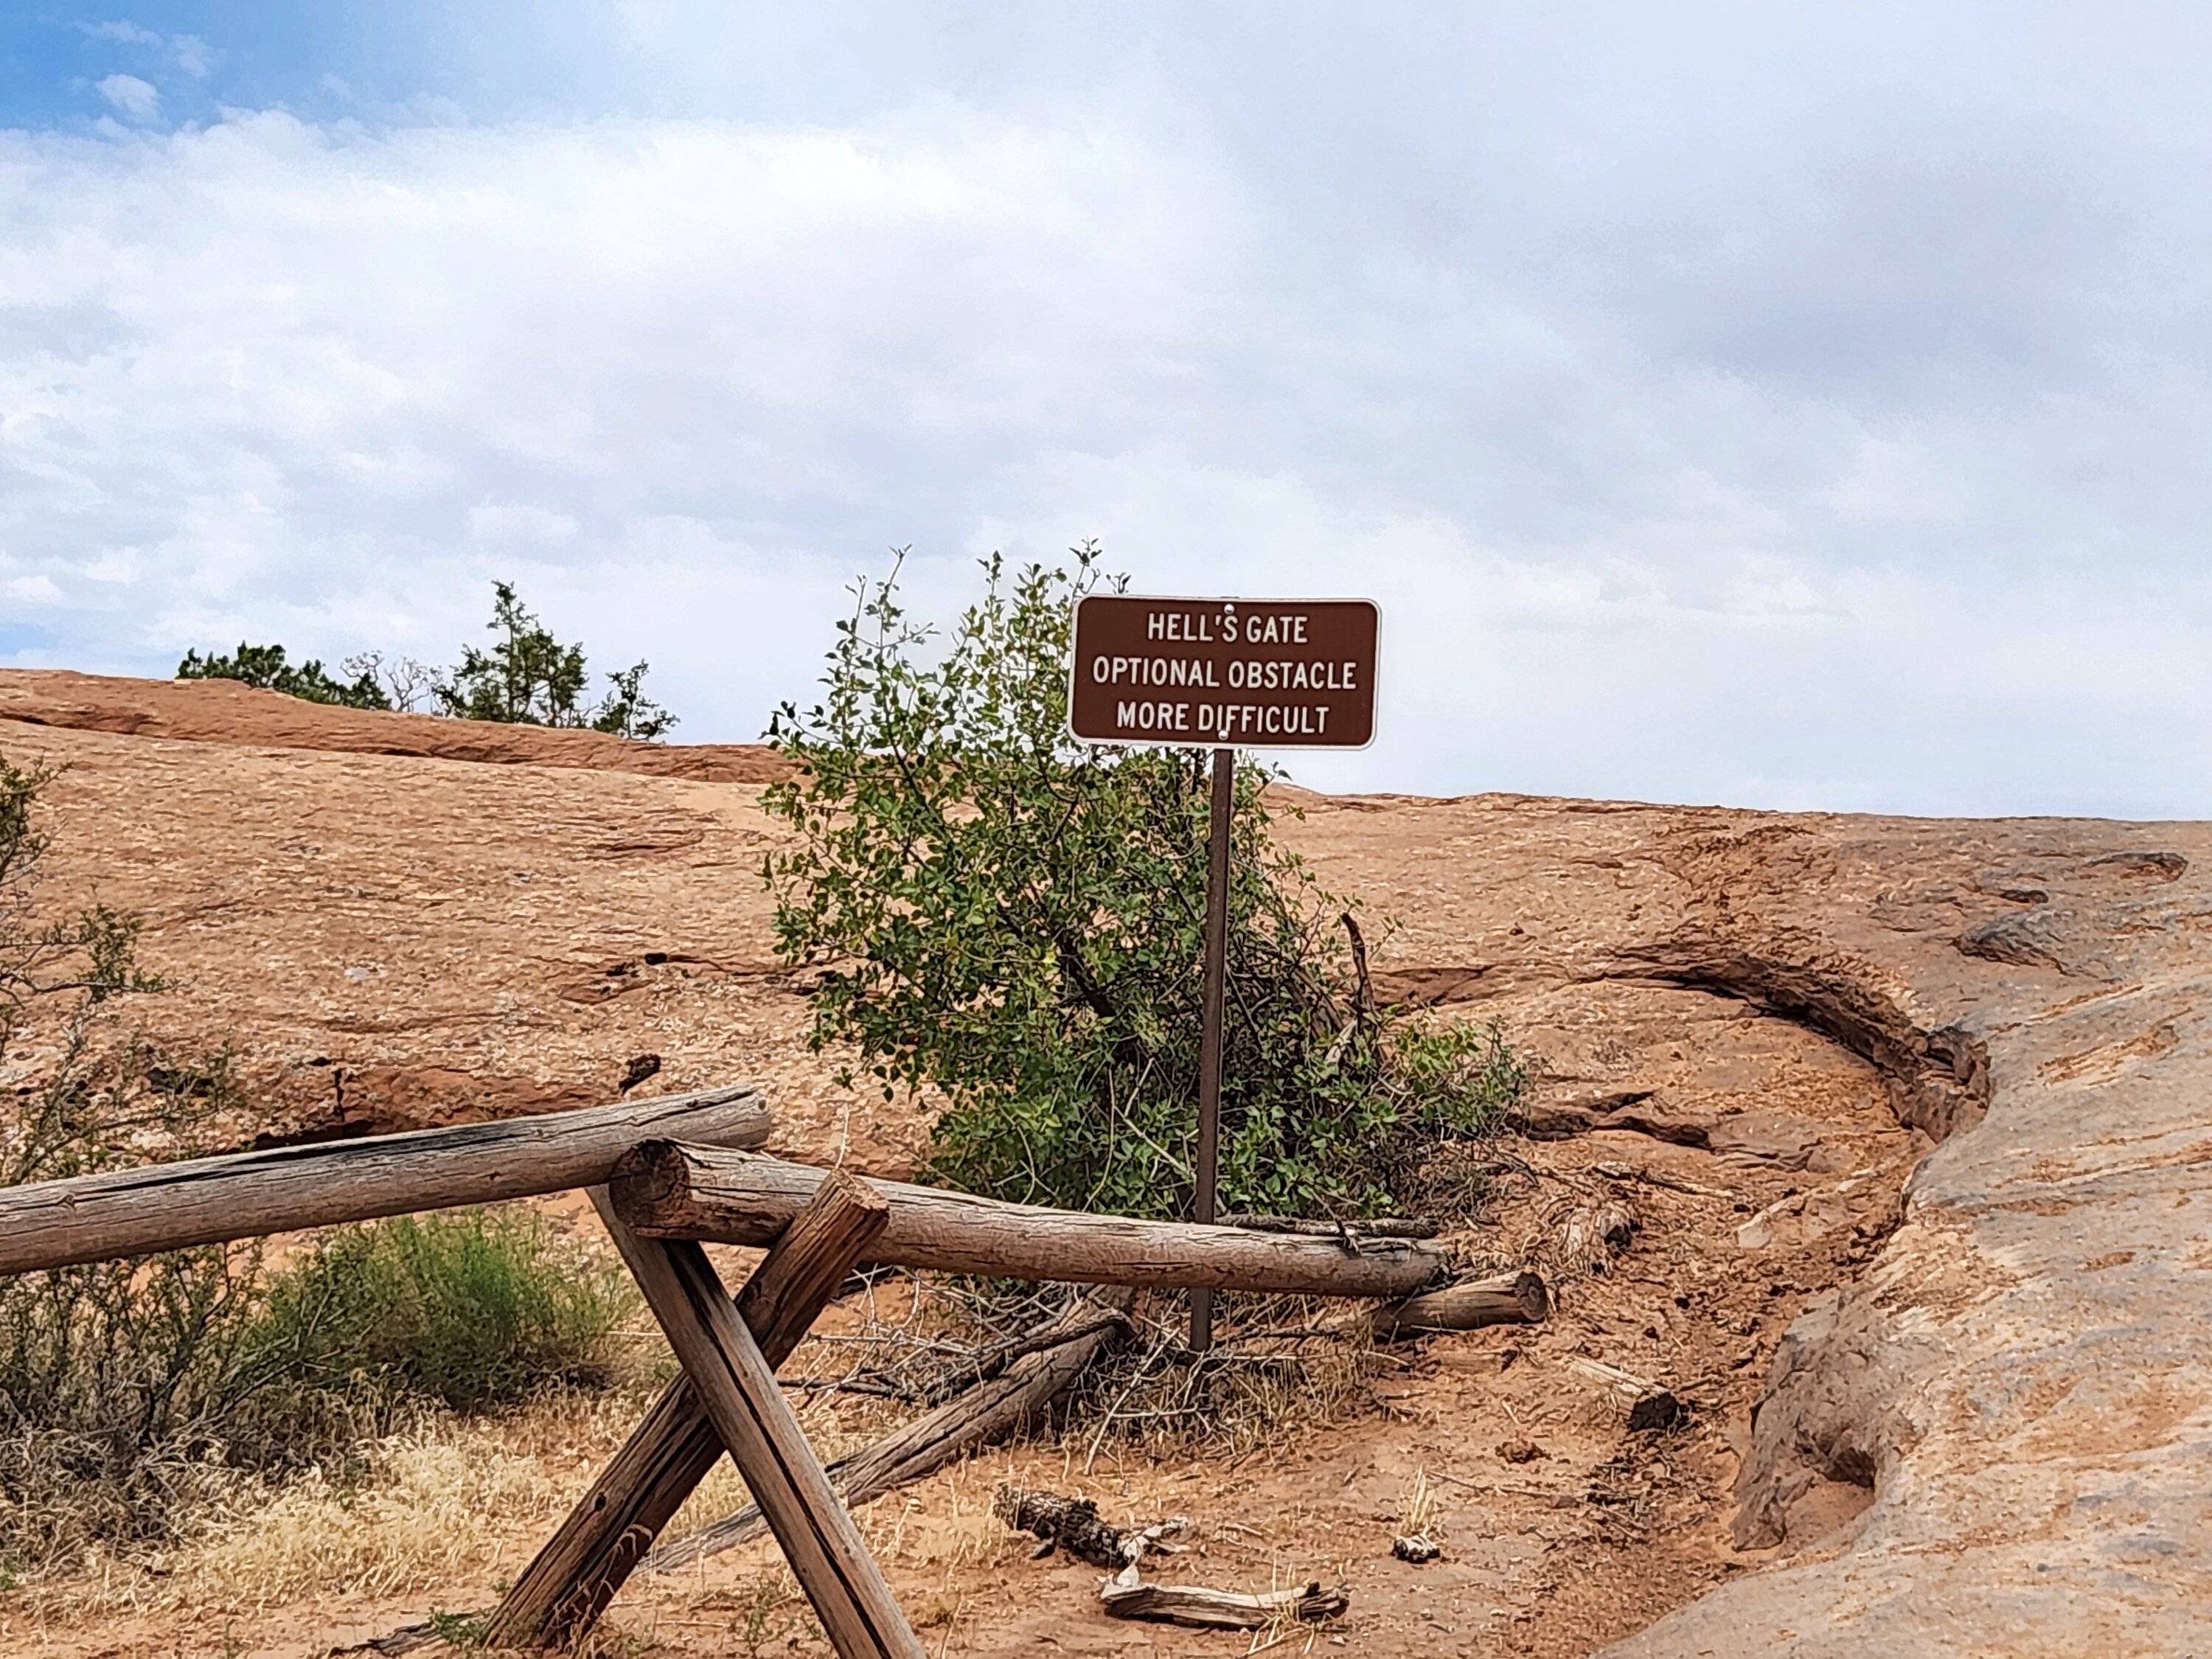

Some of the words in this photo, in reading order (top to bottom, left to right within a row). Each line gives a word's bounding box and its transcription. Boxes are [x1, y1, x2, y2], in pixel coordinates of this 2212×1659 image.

[1148, 613, 1238, 642] HELL'S
[1246, 616, 1308, 643] GATE
[1093, 655, 1220, 687] OPTIONAL
[1228, 661, 1357, 690] OBSTACLE
[1116, 701, 1189, 731] MORE
[1197, 704, 1329, 734] DIFFICULT
